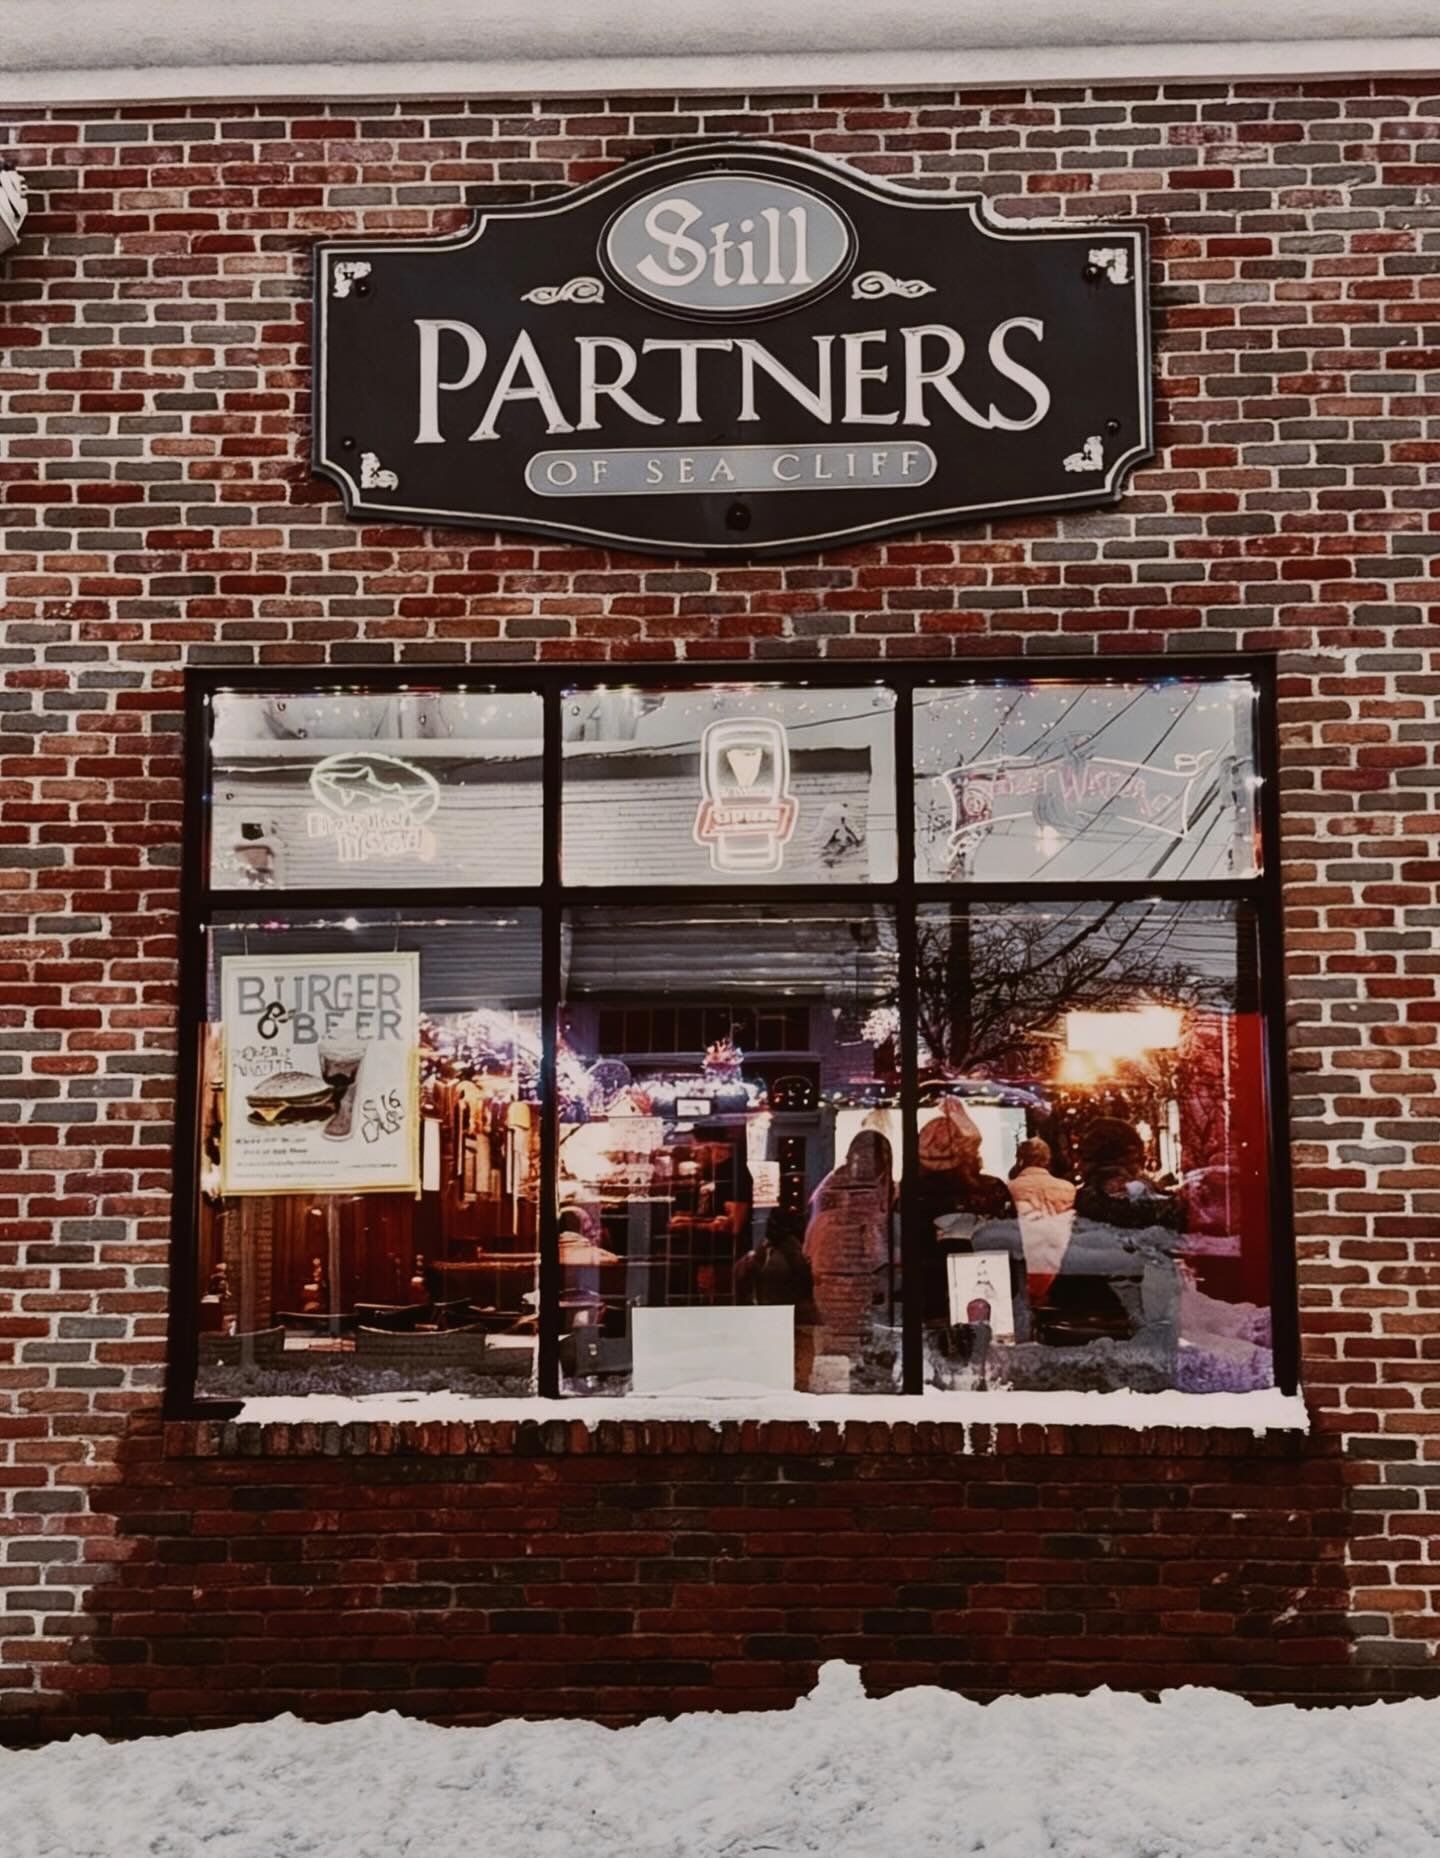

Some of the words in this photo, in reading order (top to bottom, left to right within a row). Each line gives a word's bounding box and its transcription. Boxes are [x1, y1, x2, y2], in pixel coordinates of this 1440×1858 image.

[635, 198, 812, 288] Still
[413, 317, 1052, 445] PARTNERS
[545, 460, 610, 487] OF
[646, 456, 736, 484] SEA
[772, 449, 920, 481] CLIFF
[237, 973, 402, 1015] BURGER
[293, 1010, 402, 1044] BEER
